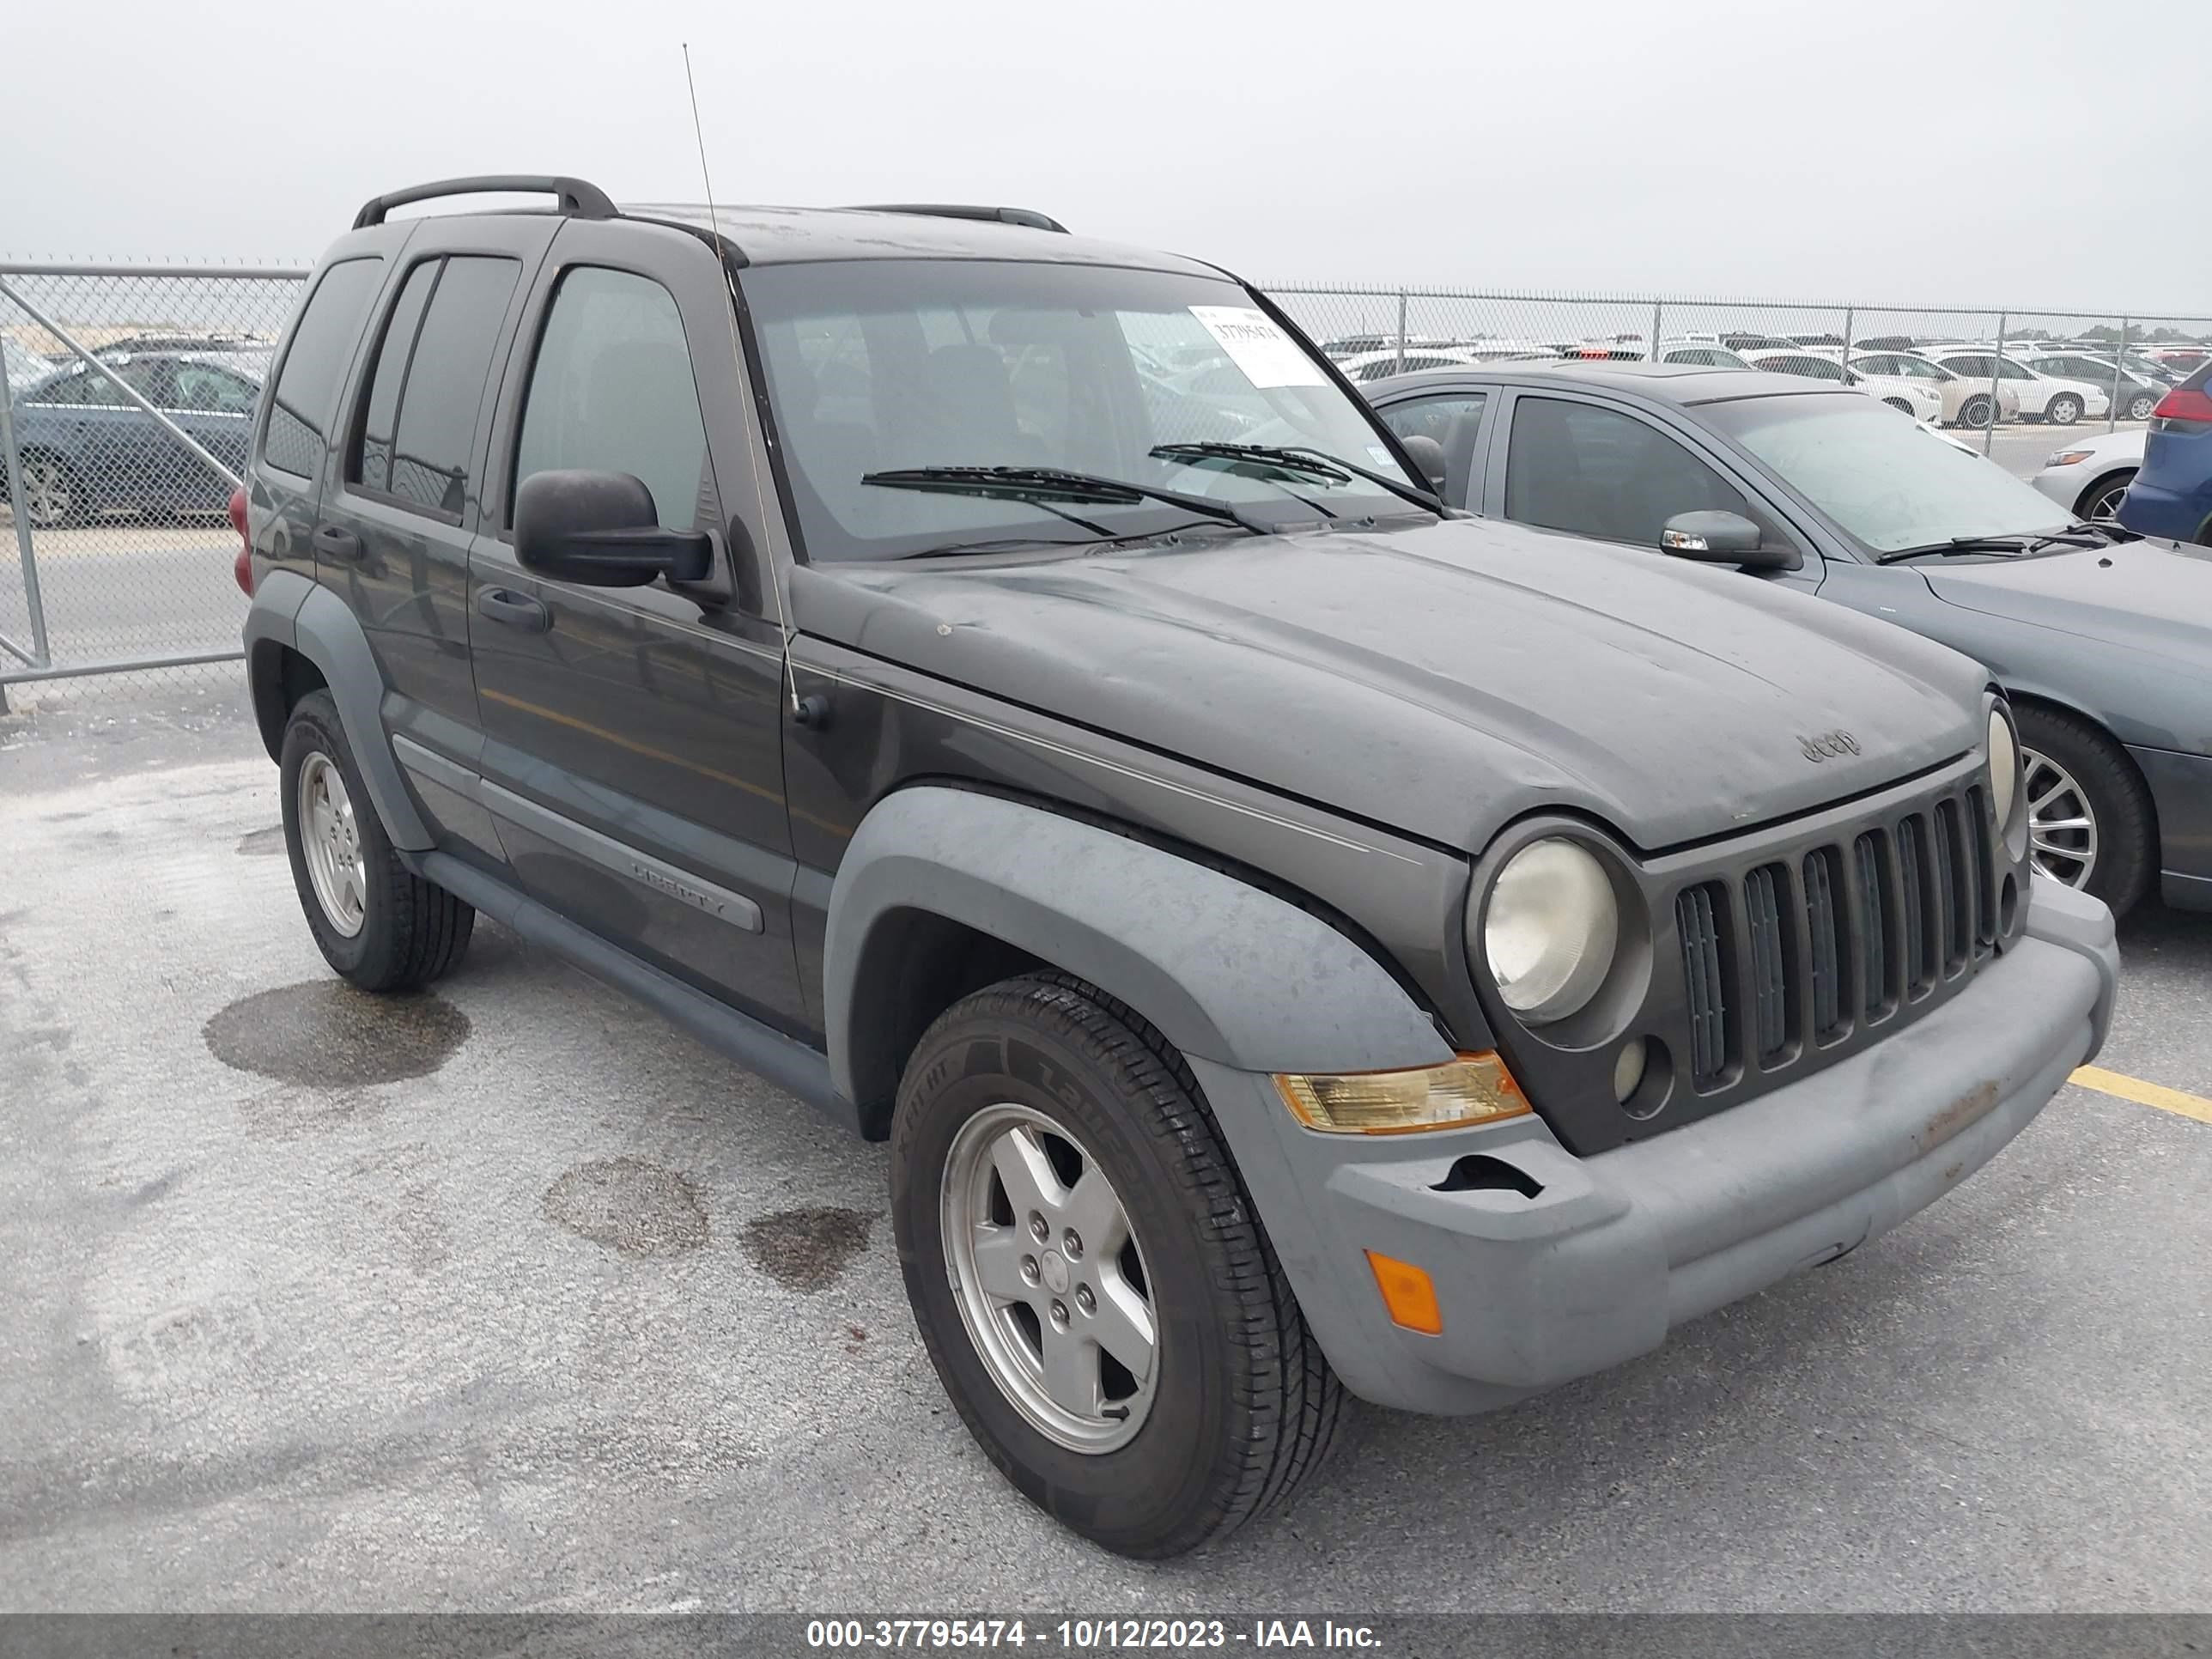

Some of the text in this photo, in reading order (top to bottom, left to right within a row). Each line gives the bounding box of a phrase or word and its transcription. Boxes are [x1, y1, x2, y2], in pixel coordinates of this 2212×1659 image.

[1214, 324, 1279, 340] 37795474
[1796, 729, 1863, 763] Jeep
[631, 863, 726, 914] LIBERTY
[926, 1058, 948, 1091] HT
